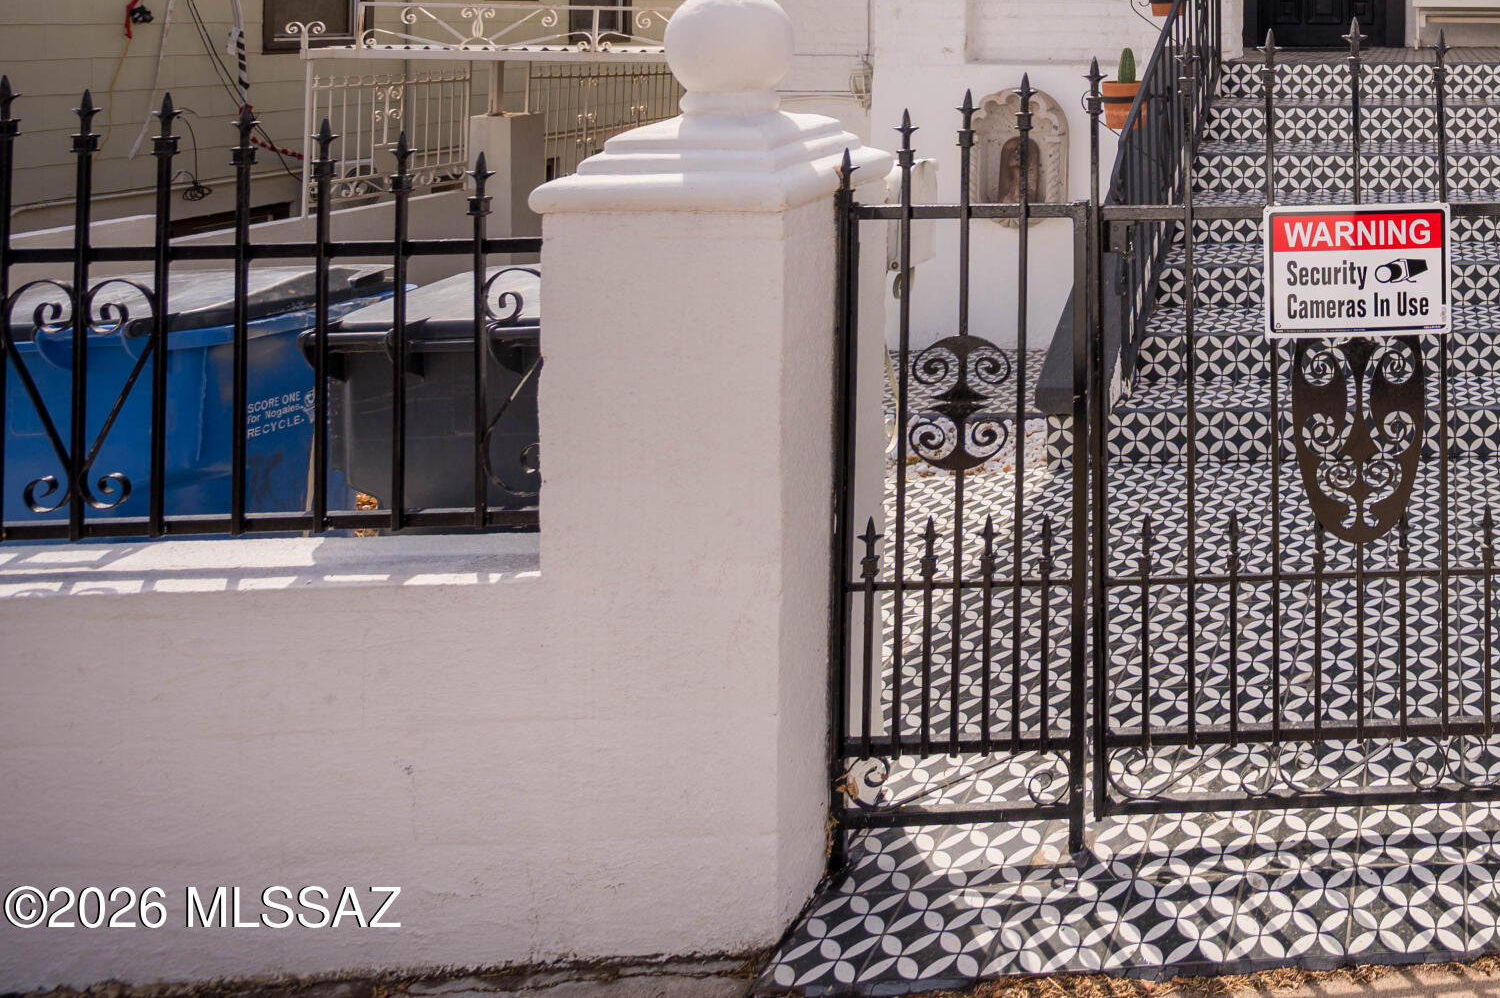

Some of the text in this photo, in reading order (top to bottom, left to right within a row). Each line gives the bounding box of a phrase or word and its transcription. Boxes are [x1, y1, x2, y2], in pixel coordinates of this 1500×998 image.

[1284, 218, 1431, 248] WARNING
[1286, 259, 1367, 290] Security
[1287, 293, 1367, 319] Cameras
[1374, 292, 1390, 317] In
[1397, 291, 1429, 316] Use
[247, 391, 301, 413] SCORE ONE
